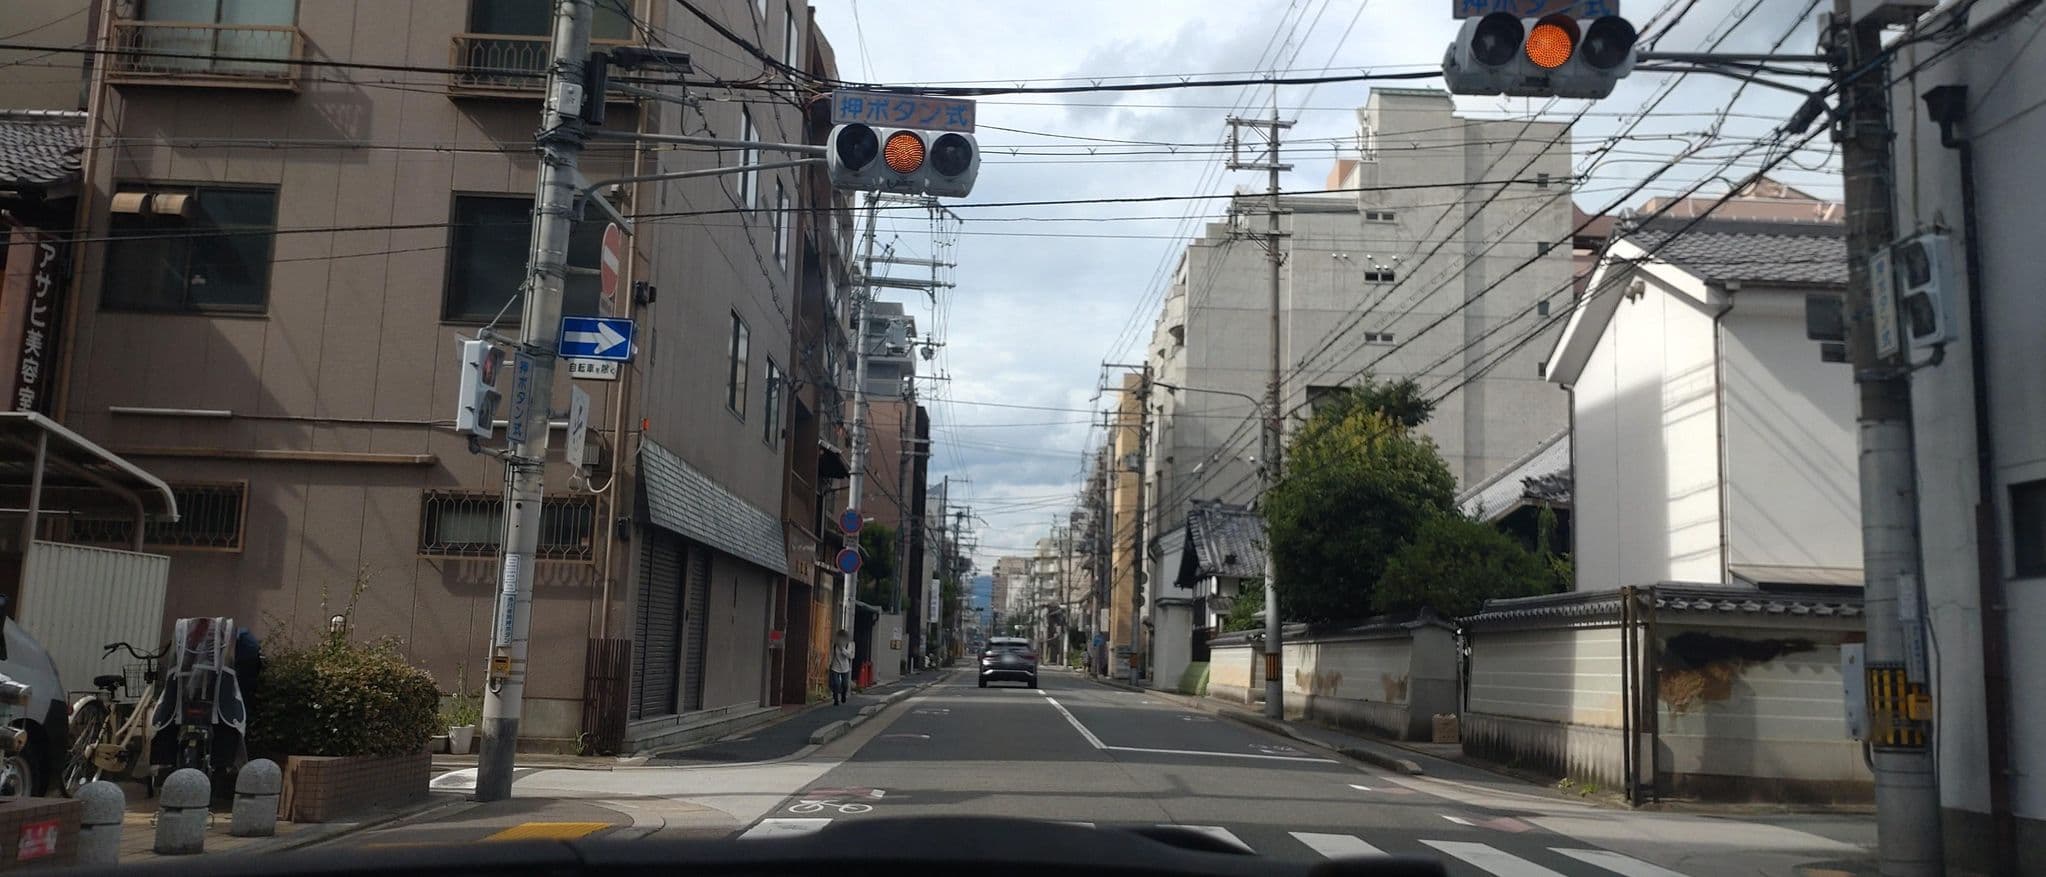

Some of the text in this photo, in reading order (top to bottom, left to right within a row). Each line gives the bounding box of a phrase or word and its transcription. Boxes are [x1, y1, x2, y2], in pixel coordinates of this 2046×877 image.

[840, 95, 968, 126] 押ボタン式
[17, 240, 56, 413] アサヒ美容室
[569, 362, 616, 375] 自転車を除く
